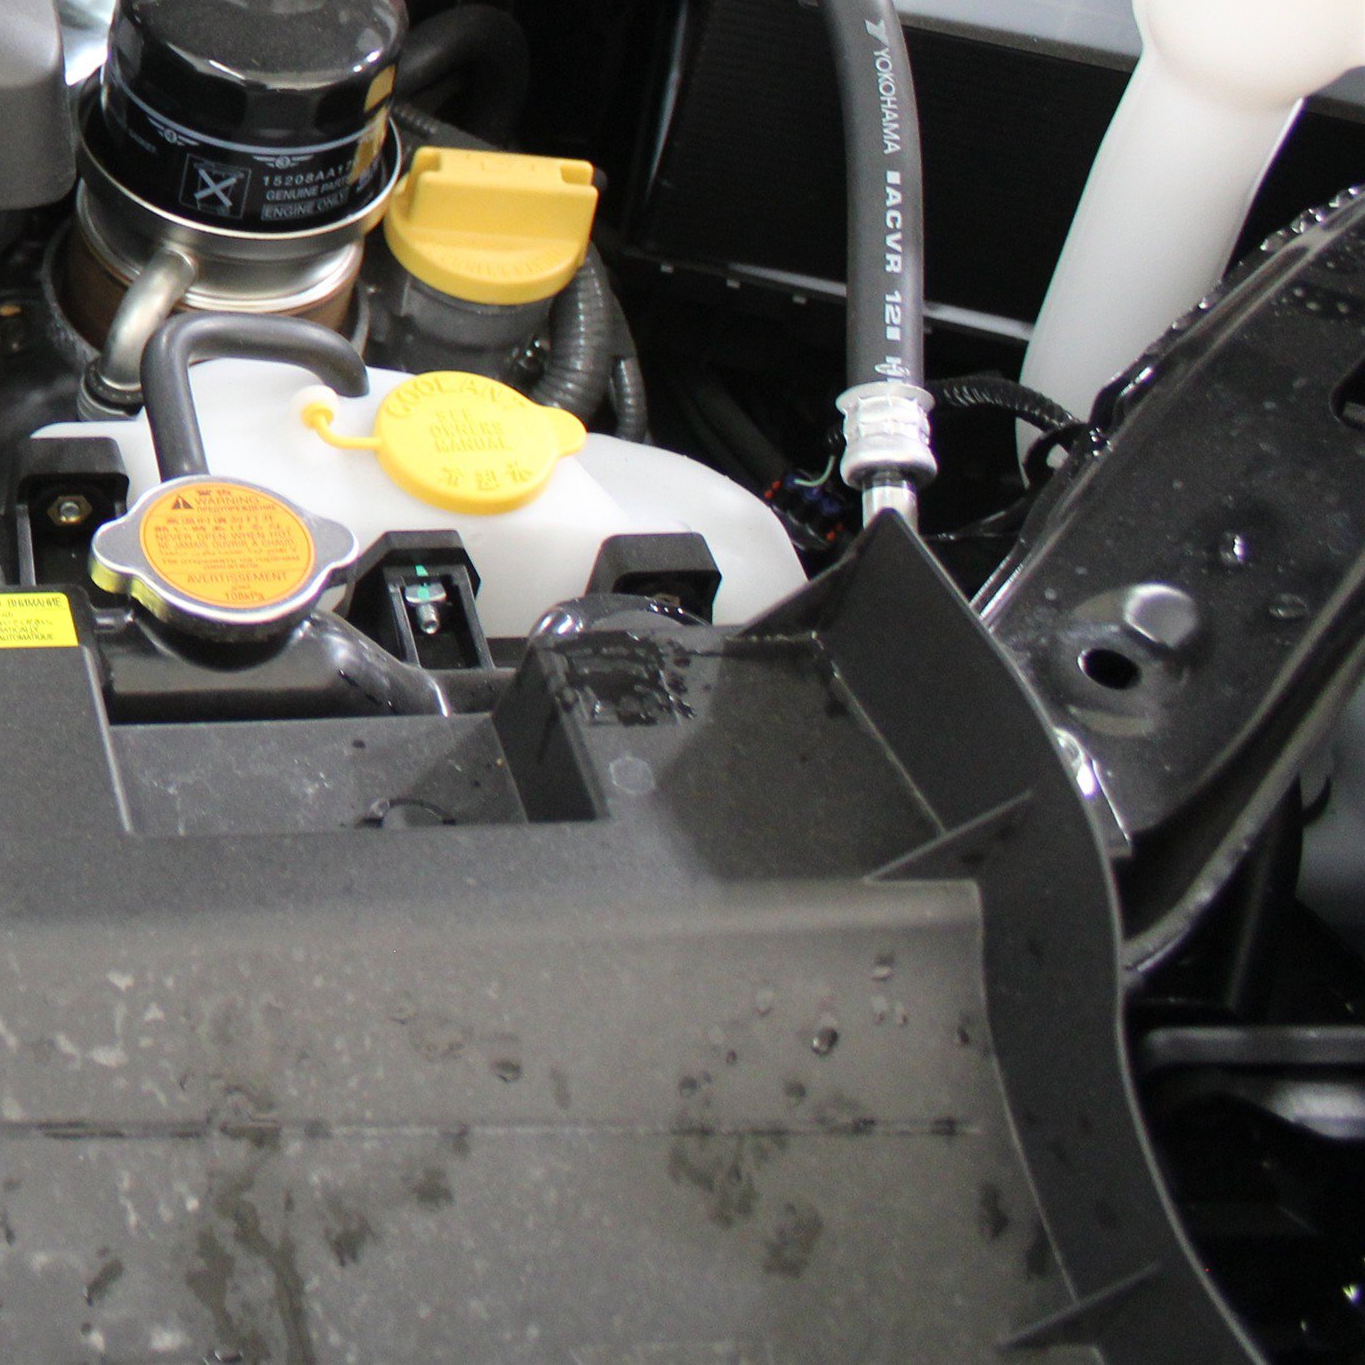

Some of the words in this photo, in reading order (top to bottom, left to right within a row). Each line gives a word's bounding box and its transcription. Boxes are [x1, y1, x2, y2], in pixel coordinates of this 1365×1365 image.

[875, 47, 900, 155] YOKOHAMA
[266, 185, 319, 201] GENUINE
[263, 202, 315, 220] ENGINE
[886, 185, 904, 273] ACVR
[386, 376, 527, 419] COOLANT
[434, 437, 513, 453] MANUAL
[195, 495, 260, 506] WARNING
[186, 571, 289, 584] AVERTISSEMENT
